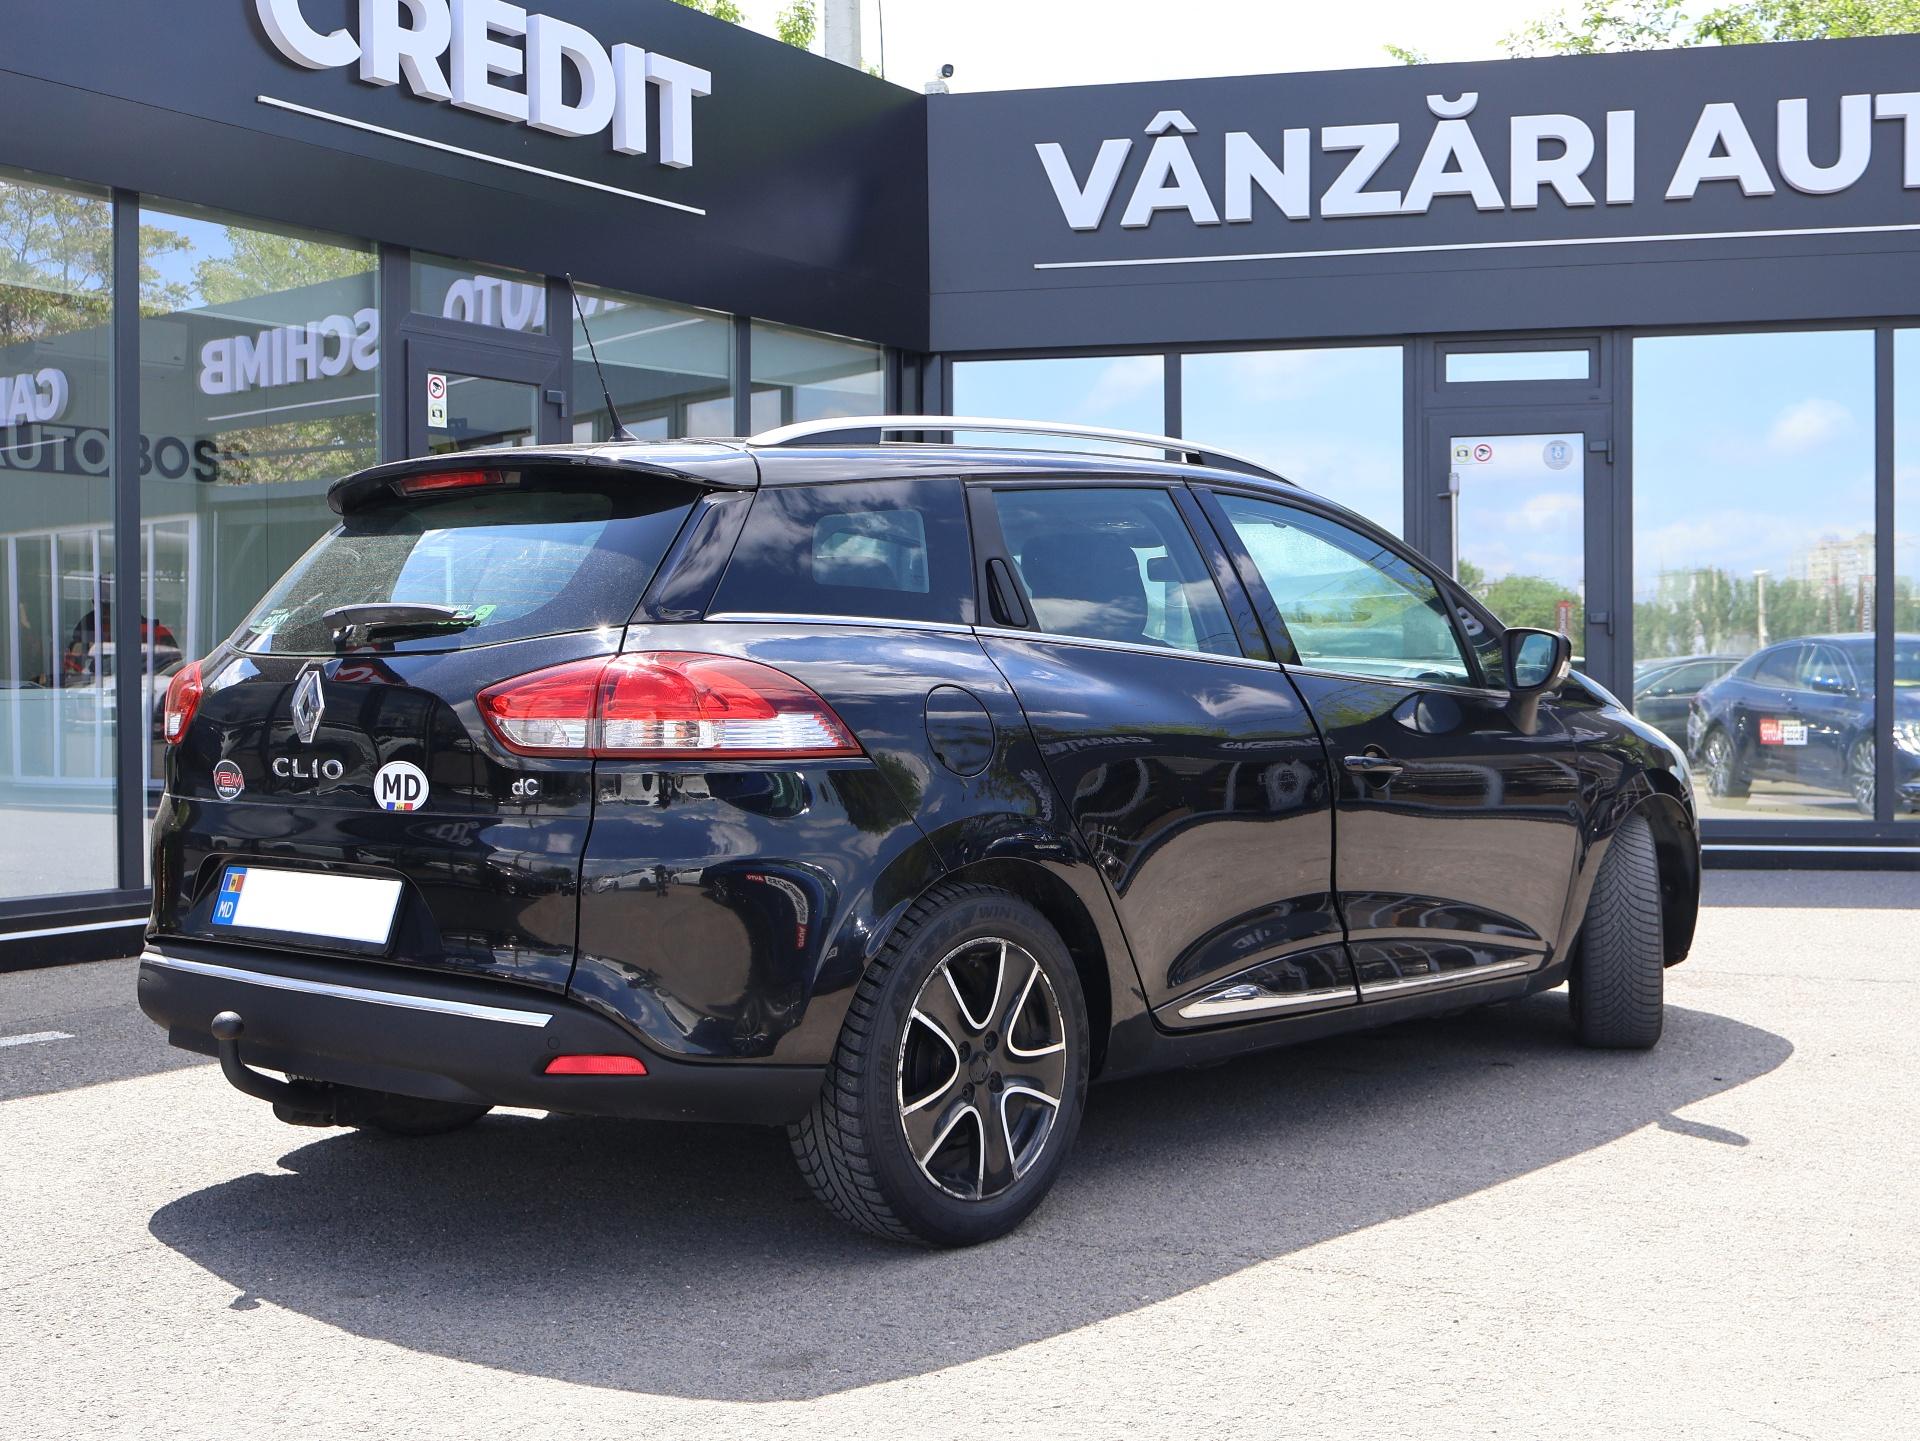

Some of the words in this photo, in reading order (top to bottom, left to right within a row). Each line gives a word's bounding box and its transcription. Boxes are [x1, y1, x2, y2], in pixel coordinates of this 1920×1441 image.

[255, 0, 712, 169] CREDIT
[1034, 92, 1636, 231] VÂNZĂRI
[0, 421, 109, 475] UTO
[272, 757, 344, 780] CLIO
[382, 773, 421, 801] MD
[217, 900, 234, 918] MD
